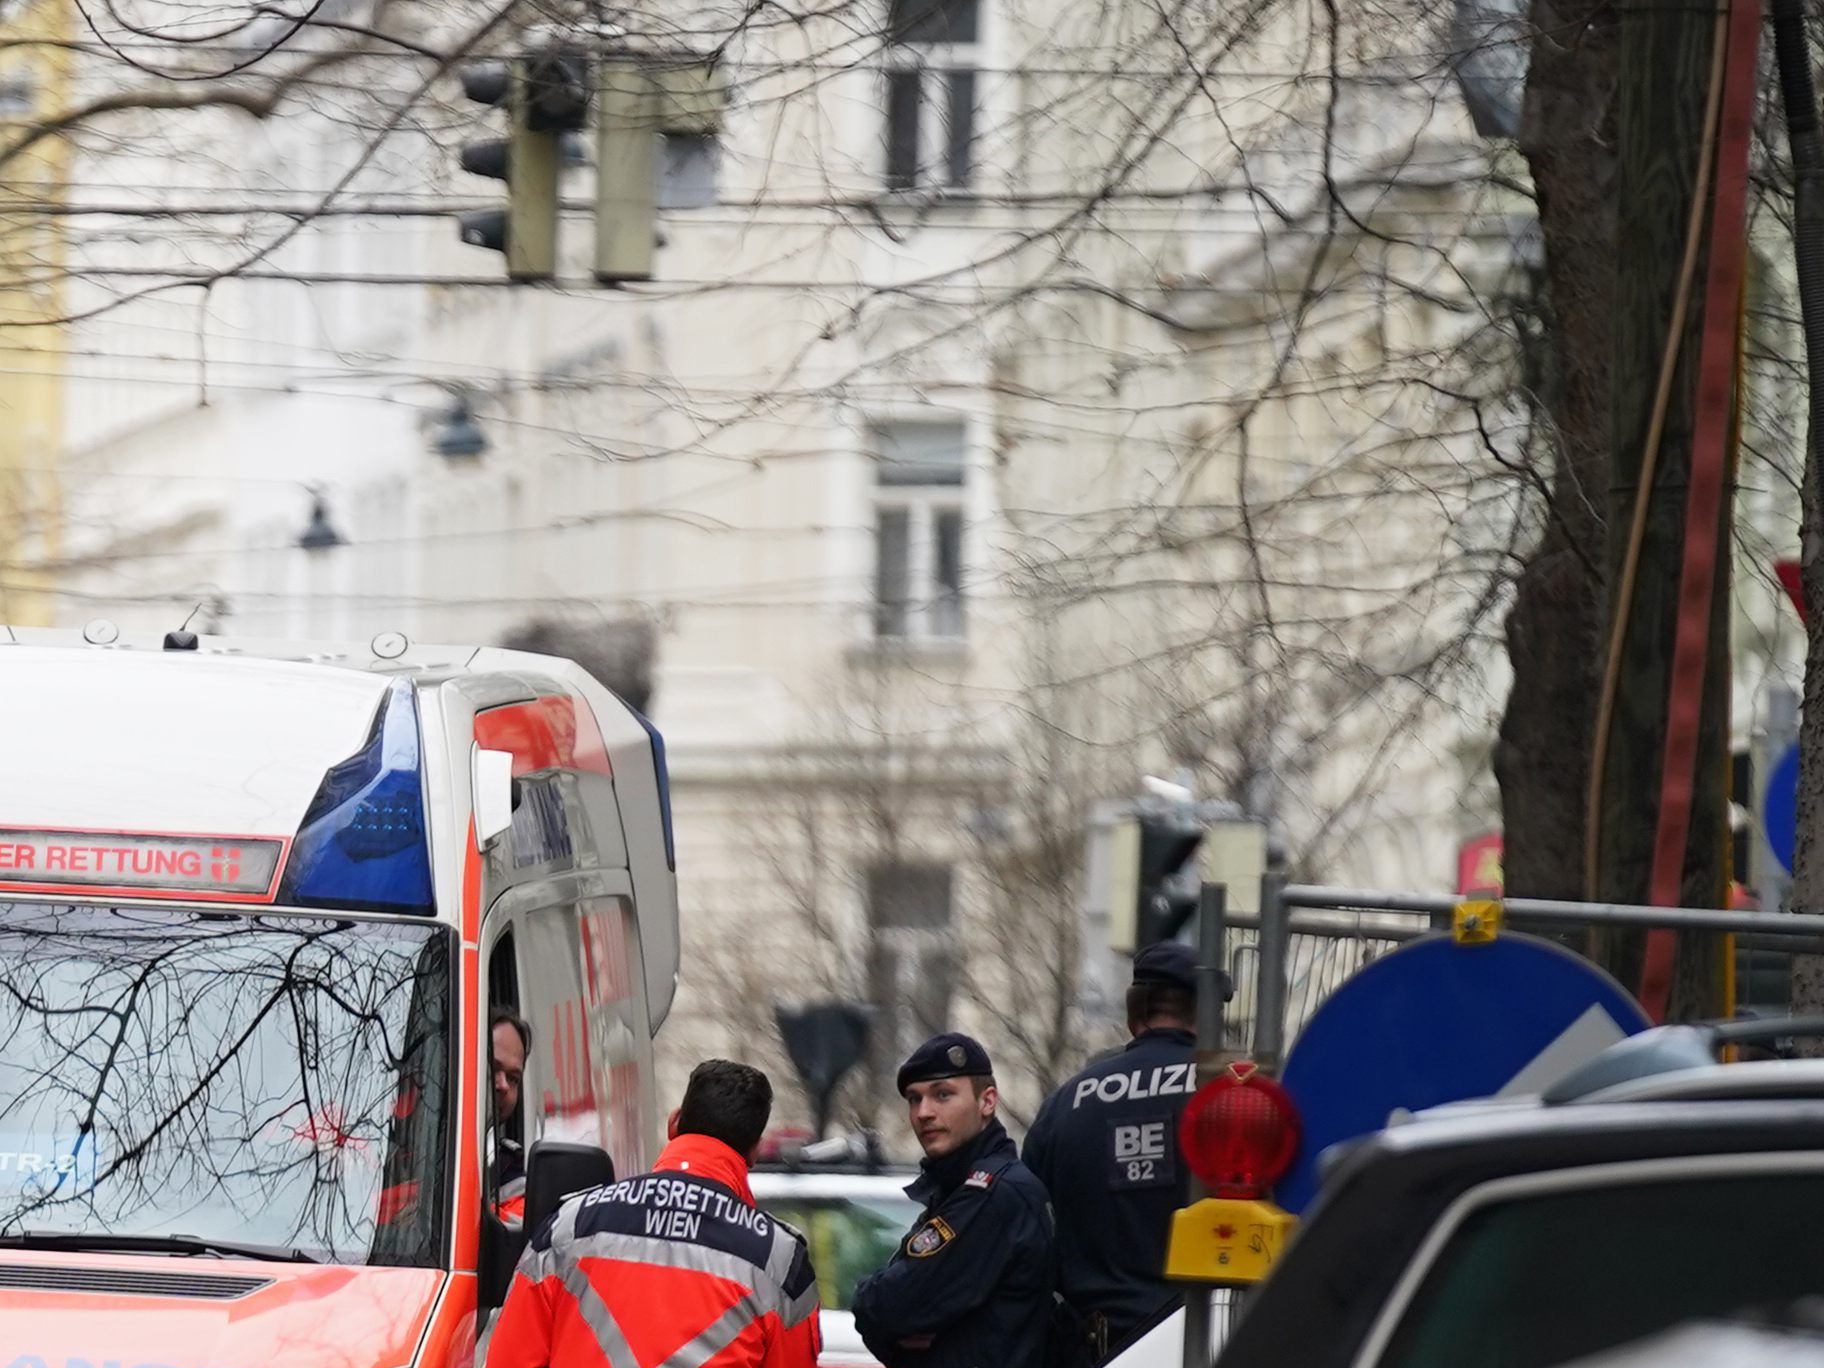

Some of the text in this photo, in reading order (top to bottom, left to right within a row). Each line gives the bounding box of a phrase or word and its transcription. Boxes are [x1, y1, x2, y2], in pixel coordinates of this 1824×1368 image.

[46, 845, 202, 877] RETTUNG
[1115, 1122, 1165, 1157] BE
[1127, 1160, 1155, 1181] 82
[584, 1178, 769, 1237] BERUFSRETTUNG
[644, 1208, 701, 1240] WIEN
